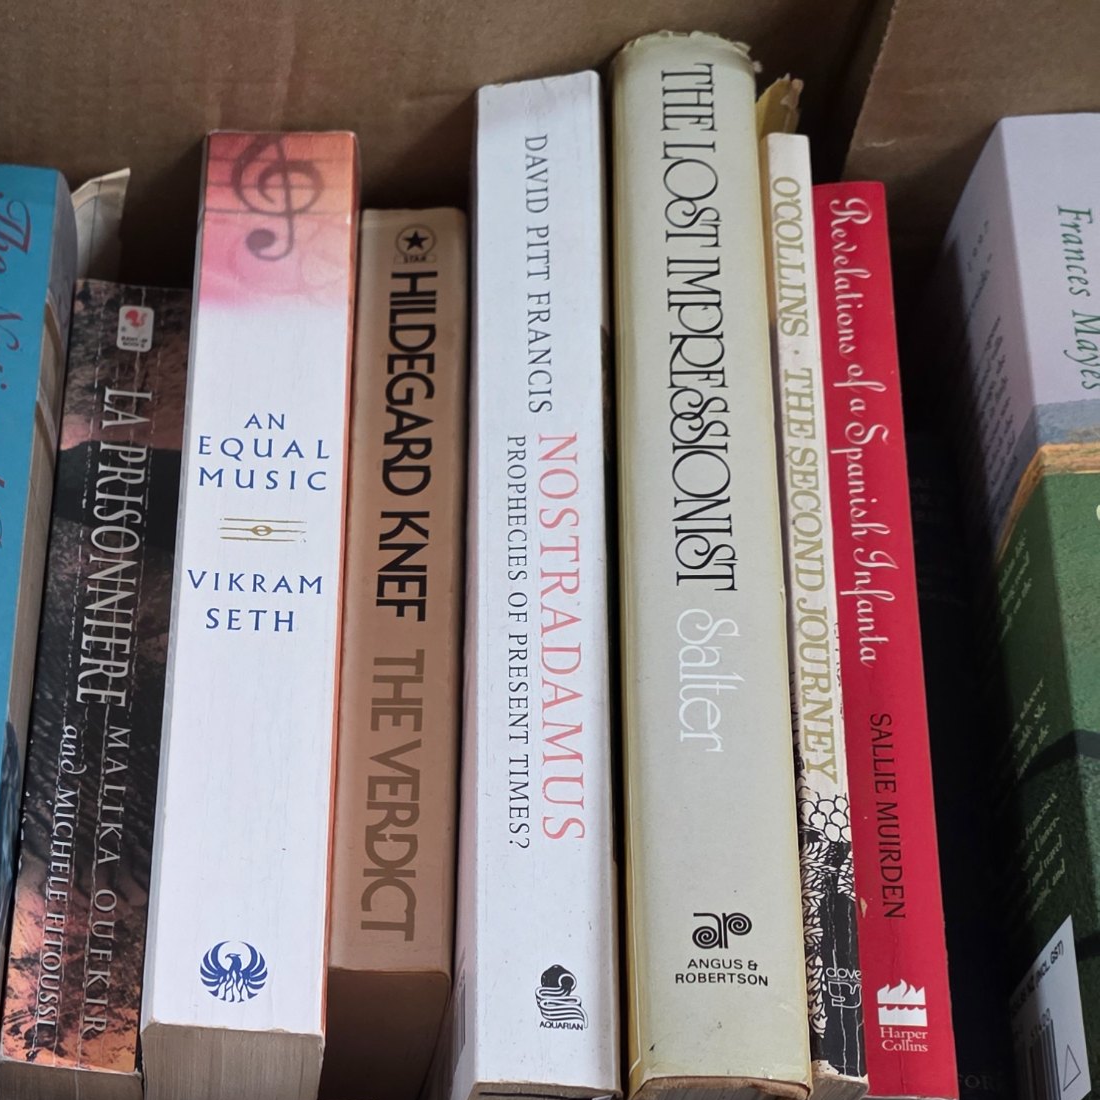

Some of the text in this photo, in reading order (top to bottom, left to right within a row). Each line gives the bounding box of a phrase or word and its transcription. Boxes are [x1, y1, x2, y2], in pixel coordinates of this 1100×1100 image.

[524, 133, 553, 414] DAVID PITT FRANCIS
[661, 62, 738, 591] THE LOST IMPRESSIONIST
[1057, 205, 1100, 392] Frances Mayes
[102, 386, 153, 429] LA
[198, 435, 330, 461] EQUAL
[198, 467, 327, 491] MUSIC
[244, 412, 286, 430] AN
[829, 198, 899, 668] Revelations of Spanish Infanta
[76, 441, 148, 708] PRISONNIERE
[187, 569, 323, 595] VIKRAM
[205, 608, 295, 633] SETH
[360, 269, 439, 941] HILDEGARD KNEF THE VERDICT
[507, 435, 531, 849] PROPHECIES OF PRESENT TIMES?
[538, 432, 585, 841] NOSTRADAMUS
[784, 366, 838, 785] THE SECOND JOURNEY
[675, 607, 746, 753] Salter
[37, 724, 87, 1027] and MICHELE FITOUSSI
[83, 725, 129, 1035] MALIKA OUFKIR
[870, 713, 906, 921] SALLIE MUIRDEN
[539, 1020, 583, 1031] AQUARIAN
[675, 972, 769, 987] ROBERTSON
[687, 958, 758, 971] ANGUS &
[879, 1027, 928, 1042] Harper
[881, 1039, 928, 1052] Collins
